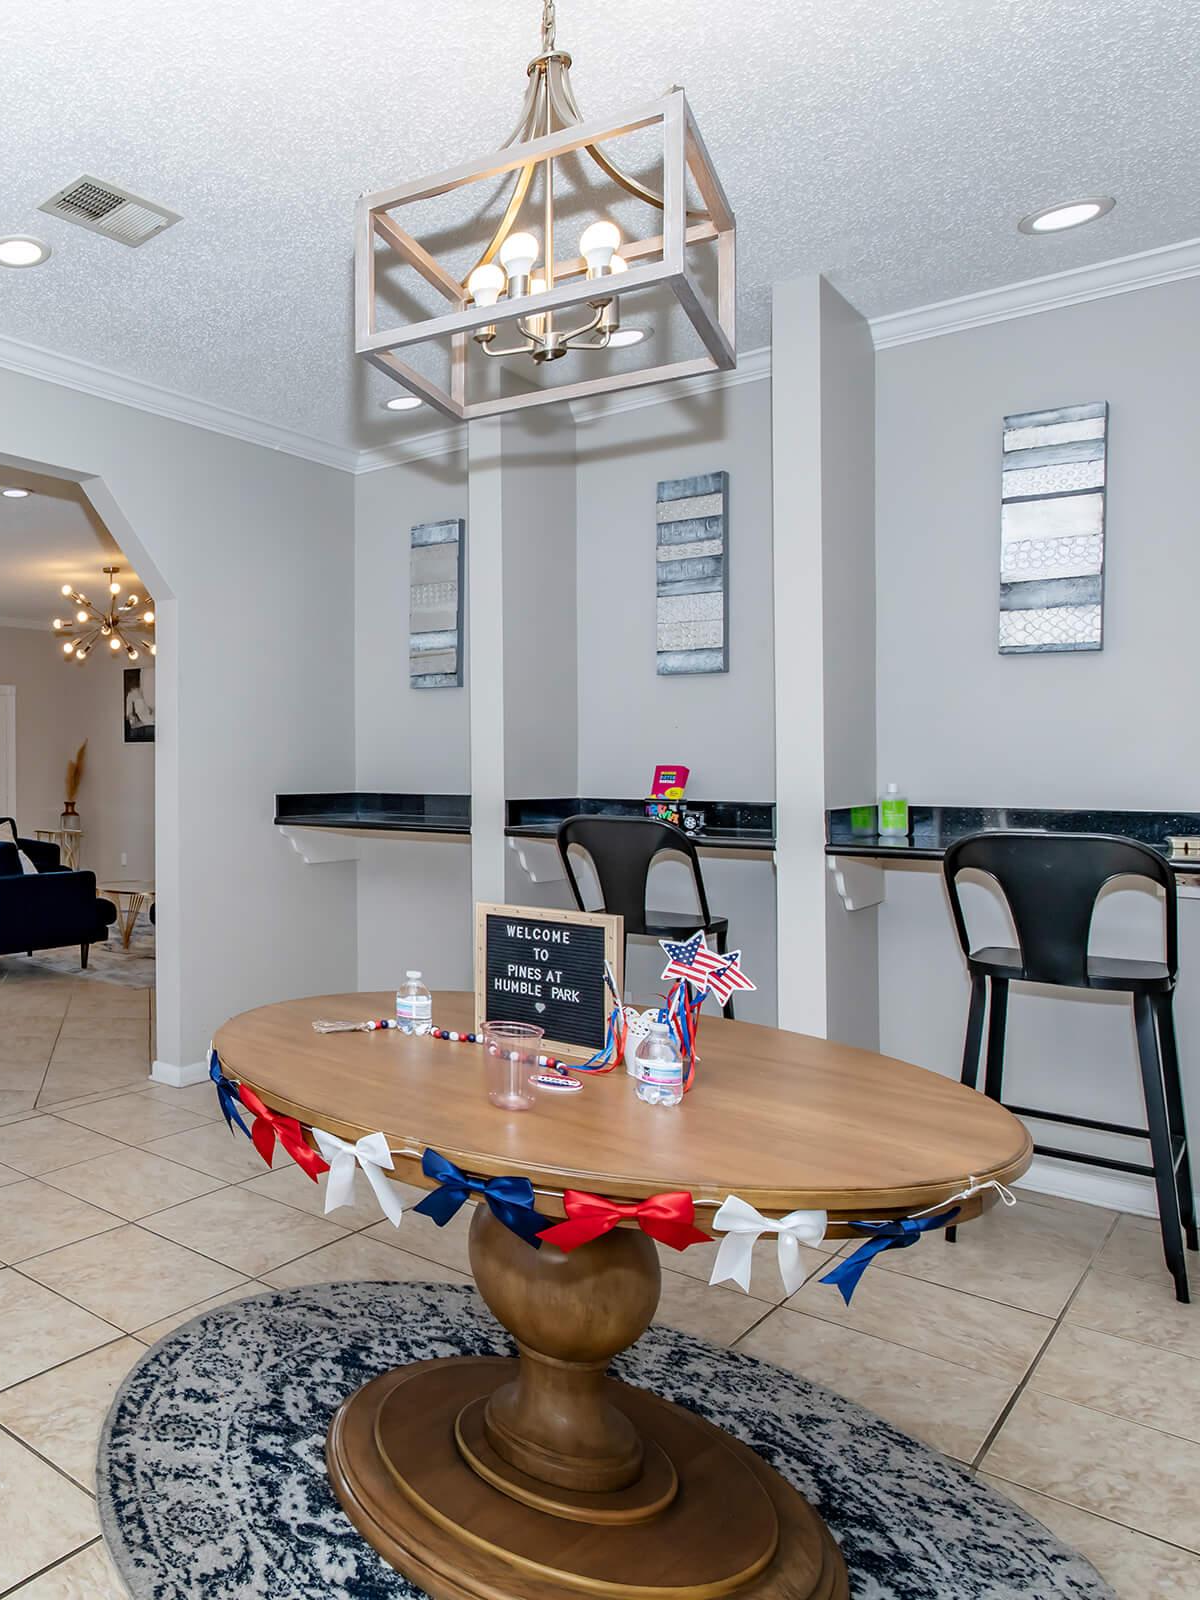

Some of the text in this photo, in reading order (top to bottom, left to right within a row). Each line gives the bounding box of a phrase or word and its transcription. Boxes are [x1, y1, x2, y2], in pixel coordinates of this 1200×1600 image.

[506, 924, 570, 945] WELCOME
[532, 947, 549, 962] TO
[507, 964, 563, 984] PINES AT
[494, 977, 580, 1003] HUMBLE PARK
